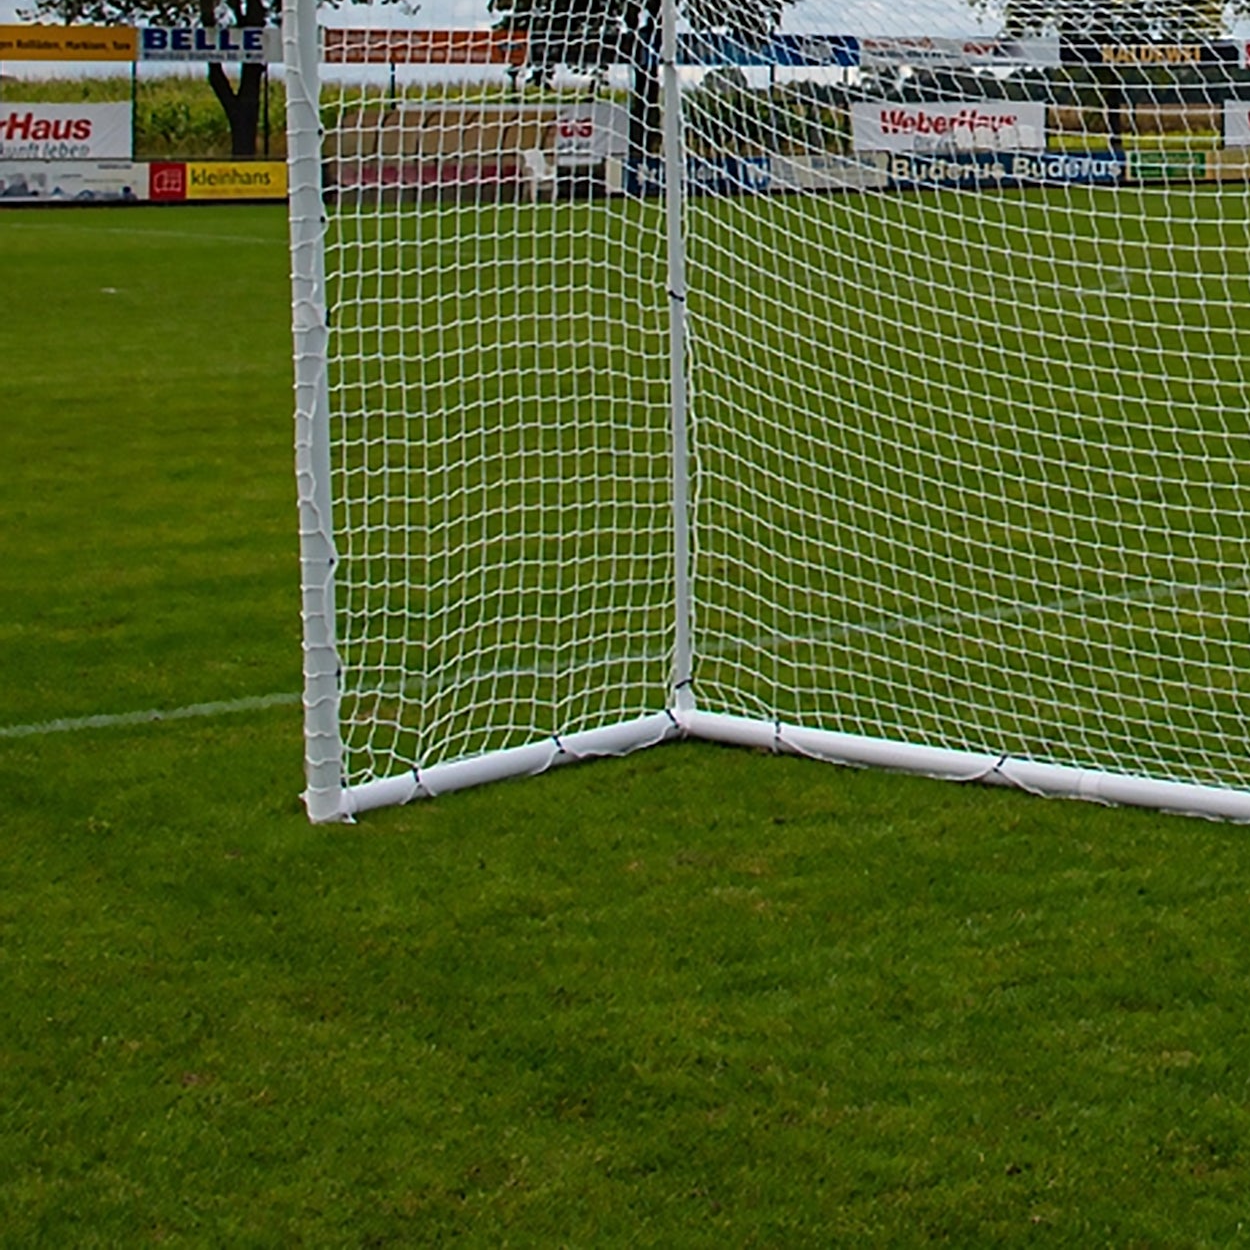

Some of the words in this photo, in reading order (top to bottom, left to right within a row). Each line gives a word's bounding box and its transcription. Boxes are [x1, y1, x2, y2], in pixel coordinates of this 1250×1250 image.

[143, 28, 263, 50] BELLE
[880, 108, 1018, 135] WeberHaus
[191, 167, 272, 186] kleinhans
[892, 157, 1005, 180] Buderus
[1012, 156, 1122, 179] Buderus
